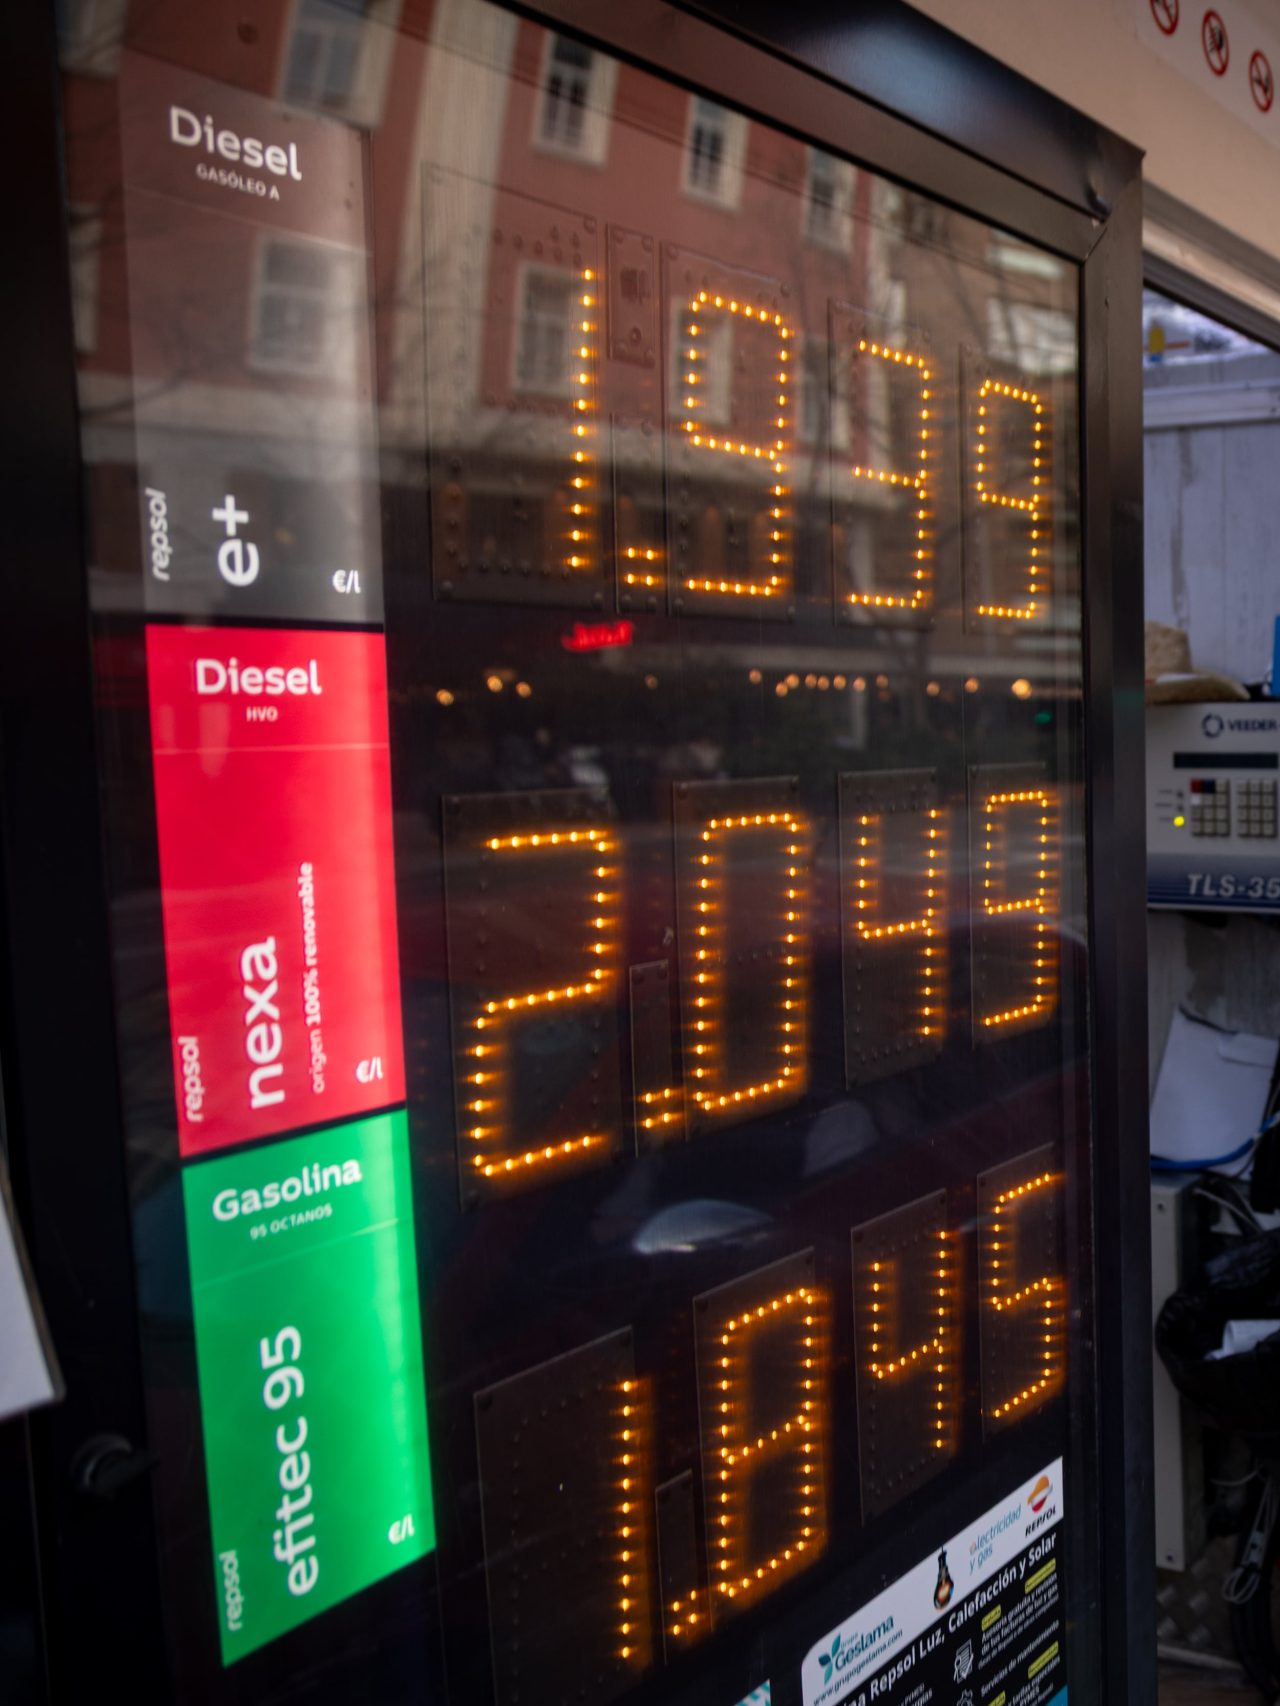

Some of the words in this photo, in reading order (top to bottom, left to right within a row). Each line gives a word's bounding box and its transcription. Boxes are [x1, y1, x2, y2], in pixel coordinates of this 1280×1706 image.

[169, 105, 302, 181] Diesel
[196, 165, 267, 197] GASÓLEO
[269, 186, 280, 200] A
[566, 266, 1044, 621] 1.939
[145, 488, 170, 581] repsol
[212, 494, 260, 587] e+
[195, 657, 322, 695] Diesel
[246, 707, 278, 722] HVO
[297, 862, 317, 961] renovable
[239, 936, 285, 1109] nexa
[302, 963, 320, 1026] 100%
[468, 789, 1052, 1179] 2.049
[178, 1035, 203, 1122] repsol
[303, 1029, 325, 1093] origen
[212, 1159, 362, 1222] Gasolina
[250, 1223, 268, 1240] 95
[269, 1203, 333, 1236] OCTANOS
[259, 1325, 304, 1411] 95
[618, 1171, 1055, 1661] 1.845
[272, 1416, 319, 1597] efitec
[969, 1503, 1021, 1555] electricidad
[1025, 1504, 1056, 1538] REPSOL
[219, 1549, 243, 1631] repsol
[969, 1559, 976, 1576] y
[978, 1543, 993, 1568] gas
[835, 1615, 894, 1671] Geslama
[870, 1645, 916, 1701] Repsol
[919, 1627, 945, 1660] Luz,
[948, 1565, 1017, 1633] Calefacción
[1019, 1558, 1027, 1580] y
[1028, 1532, 1057, 1567] Solar
[813, 1629, 903, 1706] www.grupogeslama.com
